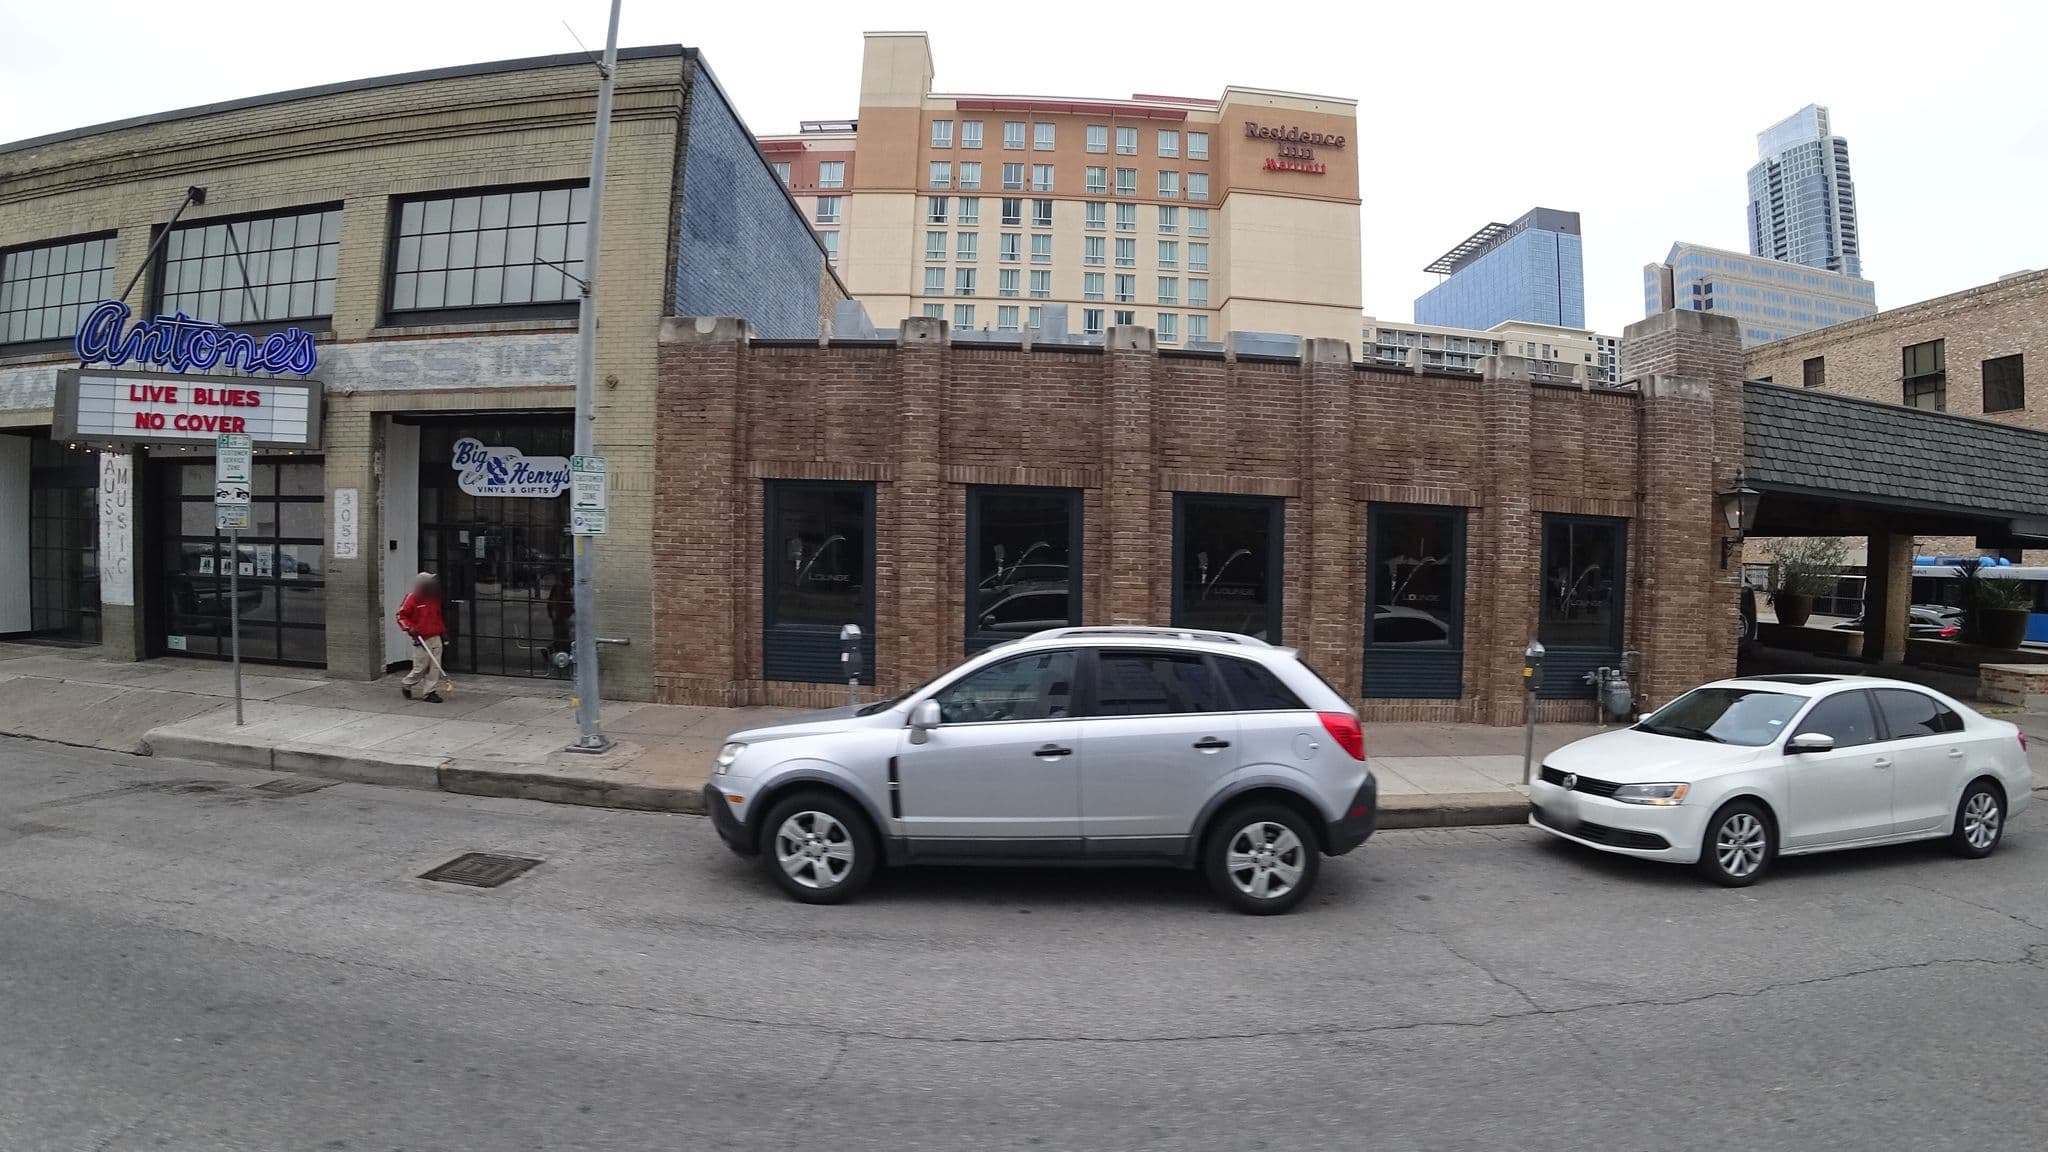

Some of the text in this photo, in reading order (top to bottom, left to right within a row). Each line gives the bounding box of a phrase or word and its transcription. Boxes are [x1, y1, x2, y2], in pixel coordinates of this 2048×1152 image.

[1245, 121, 1346, 147] Residence
[1278, 142, 1315, 160] Inn
[1263, 157, 1328, 175] Marriott
[1490, 217, 1531, 249] MARRIOTT
[74, 299, 318, 376] Antone's
[129, 384, 261, 407] LIVE BLUES
[135, 411, 246, 434] NO COVER
[455, 441, 488, 472] Big
[508, 462, 571, 493] Henry's
[477, 486, 550, 494] VINYL & GIFTS
[117, 467, 128, 575] MUSIC
[808, 573, 848, 581] LOUNGE
